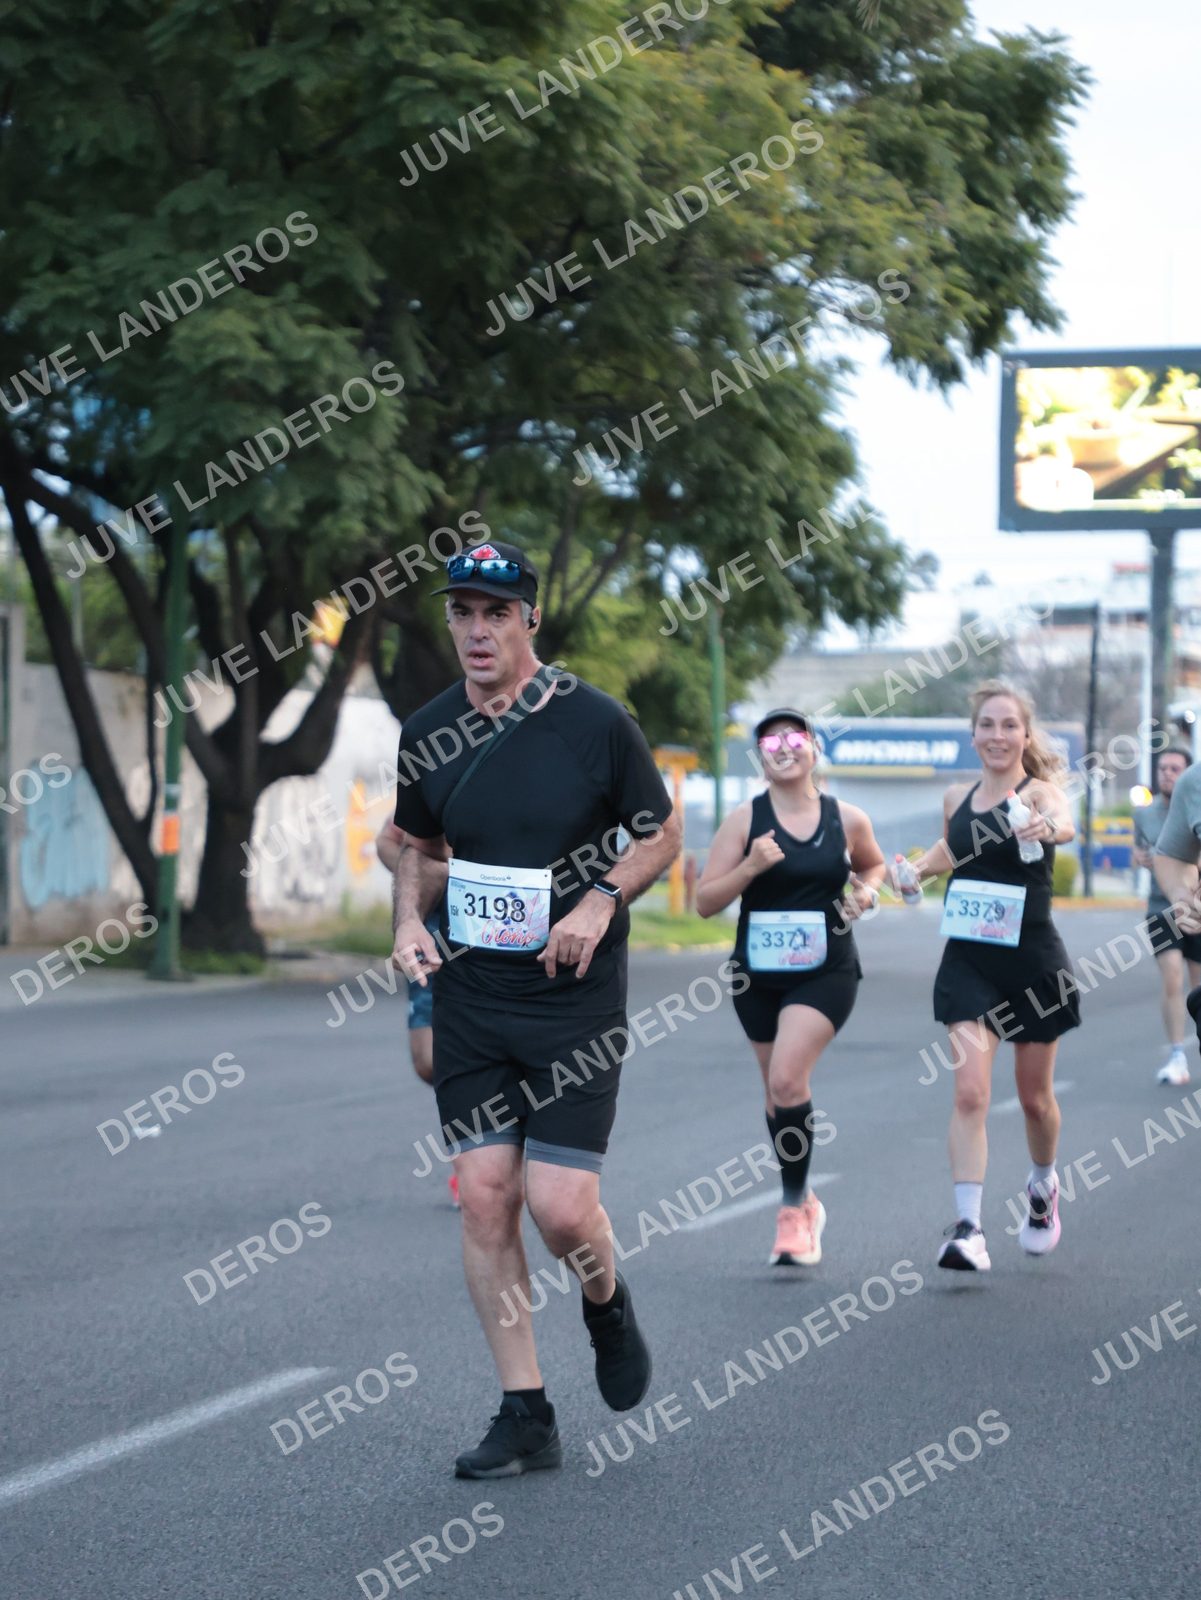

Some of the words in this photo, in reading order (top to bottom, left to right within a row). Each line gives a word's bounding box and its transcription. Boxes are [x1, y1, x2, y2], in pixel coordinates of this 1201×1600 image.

[464, 892, 526, 923] 3198
[958, 899, 1005, 921] 3379
[761, 930, 809, 948] 3371
